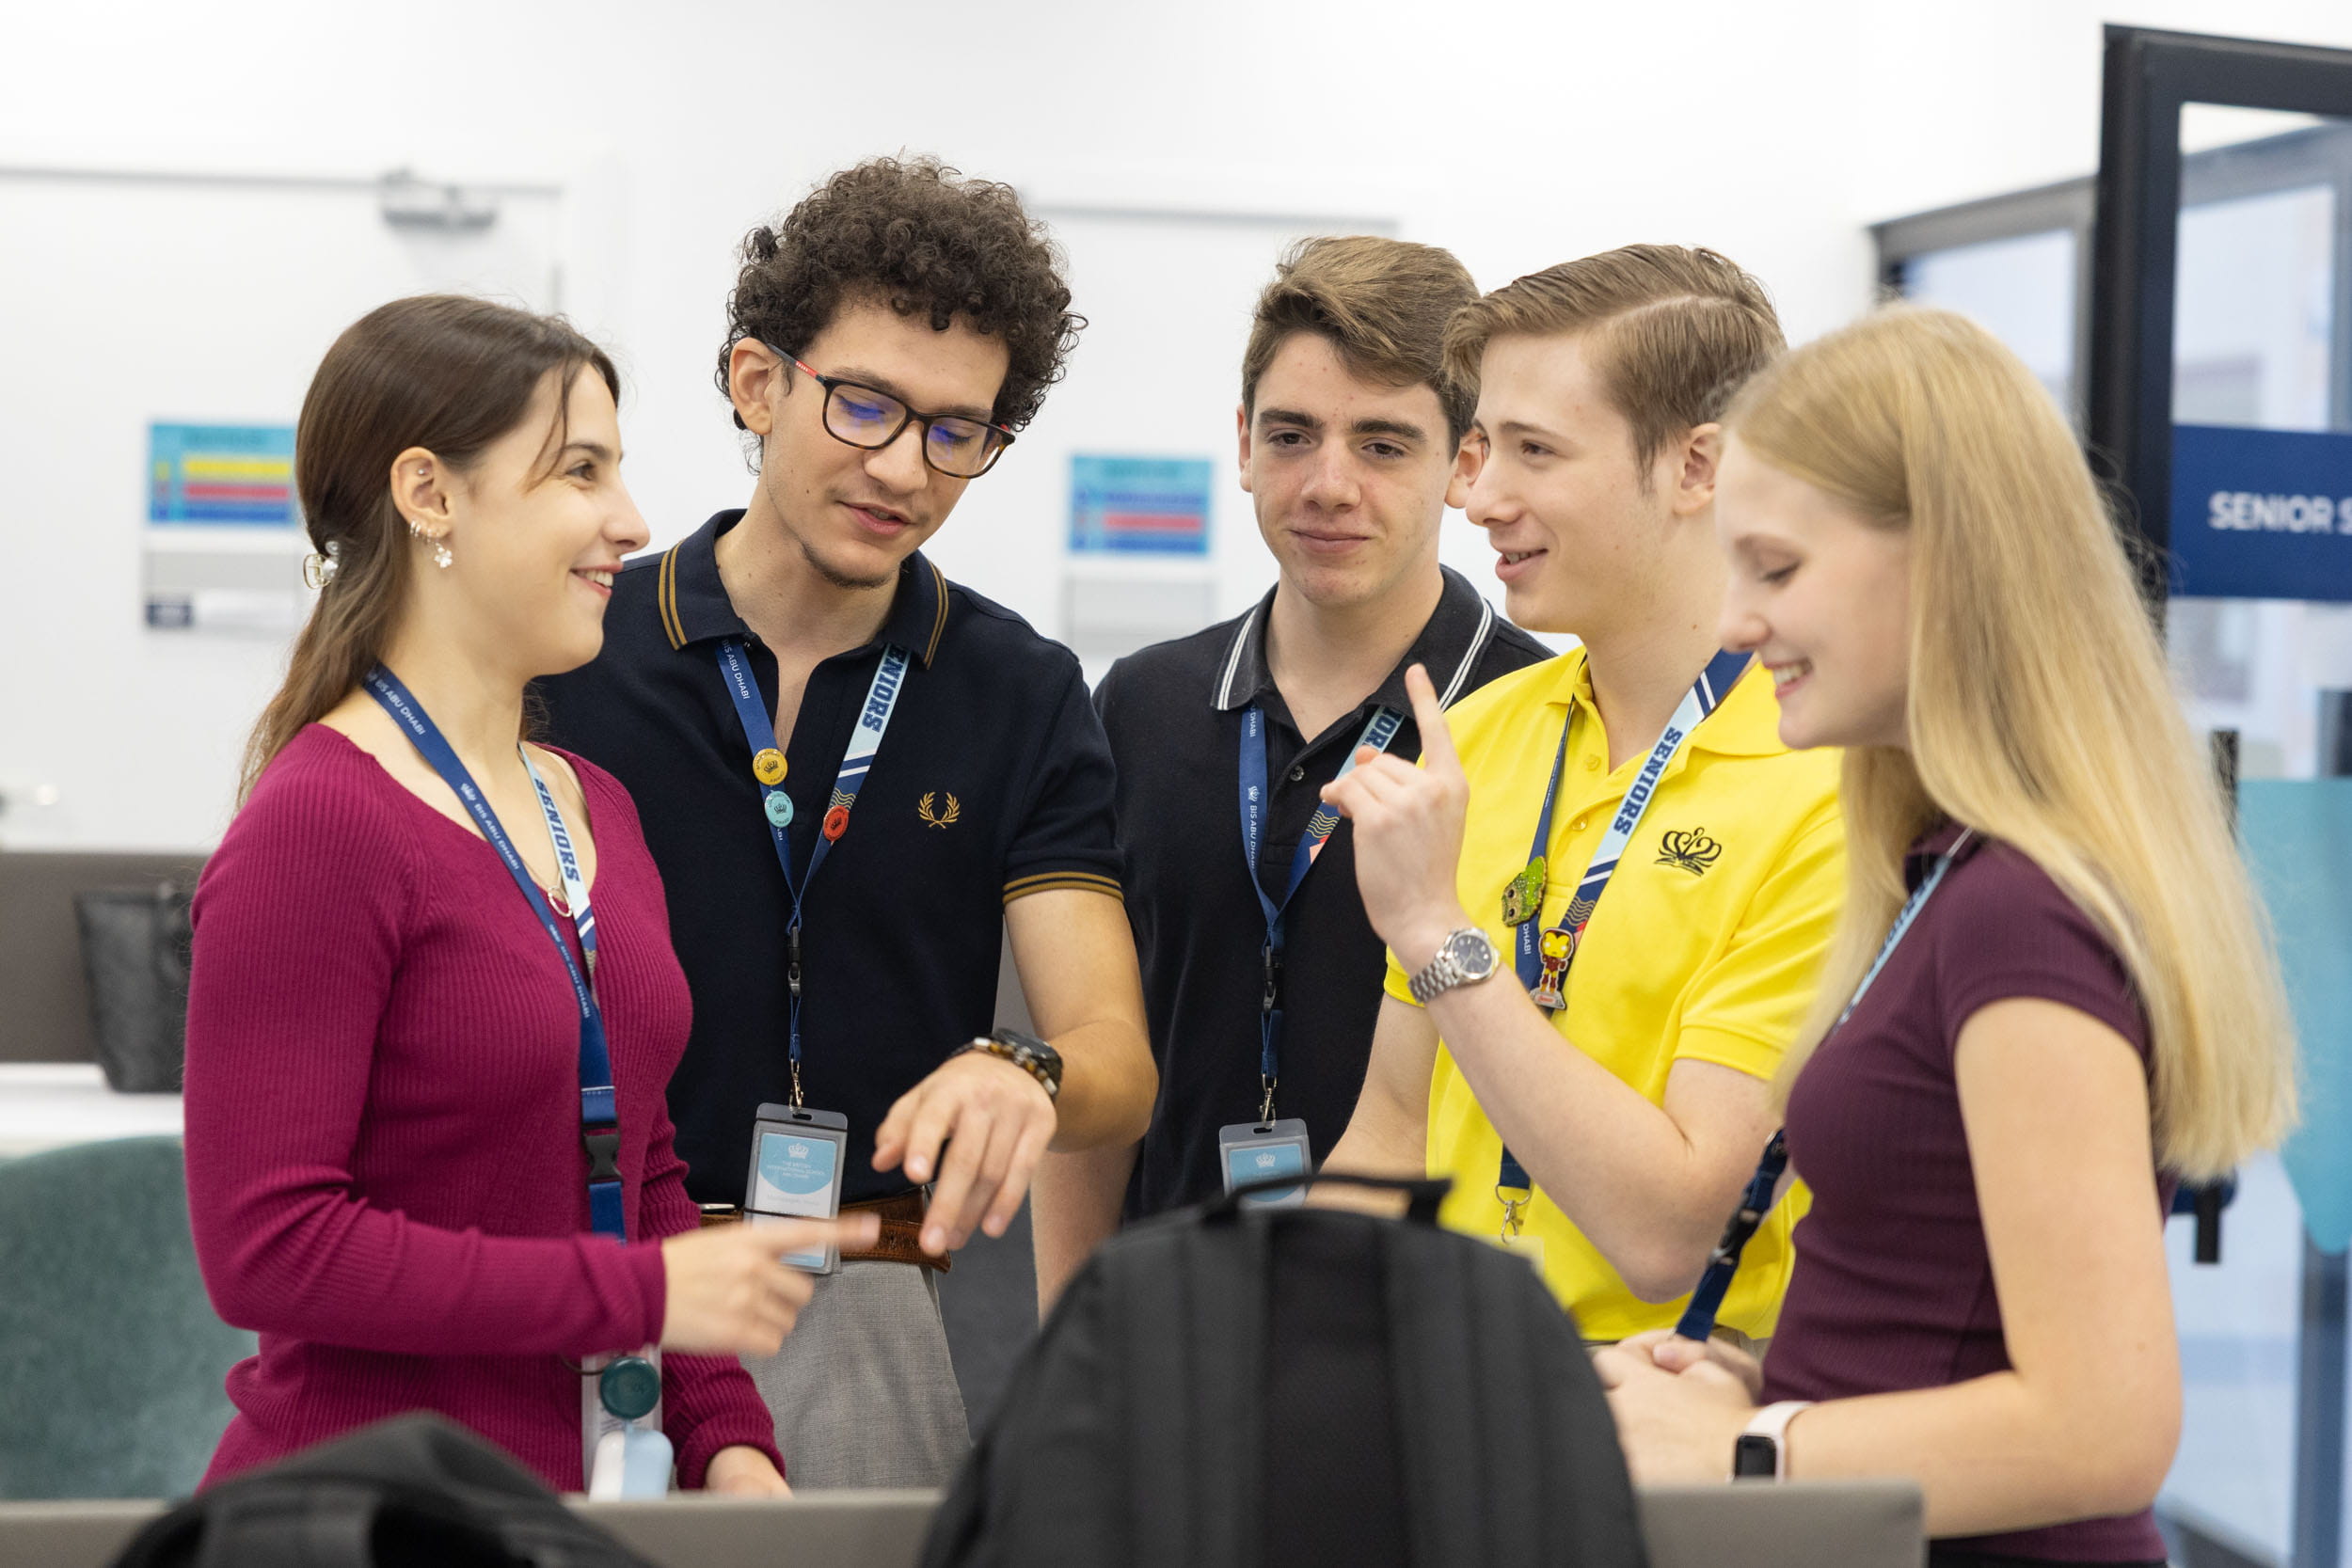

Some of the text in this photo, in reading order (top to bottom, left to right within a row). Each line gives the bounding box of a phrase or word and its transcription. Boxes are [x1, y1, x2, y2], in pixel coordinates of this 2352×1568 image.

[2208, 490, 2333, 533] SENIOR
[726, 654, 740, 672] ABU
[734, 673, 751, 699] DHABI
[384, 690, 405, 707] ABU
[400, 706, 426, 735] DHABI
[1362, 706, 1403, 749] IOR
[1613, 727, 1683, 835] SENIORS
[534, 778, 580, 882] SENIORS
[1249, 805, 1258, 819] BIS
[1249, 819, 1258, 840] ABU
[485, 819, 501, 840] ABU
[498, 839, 520, 870] DHABI
[1522, 923, 1533, 955] DHABI
